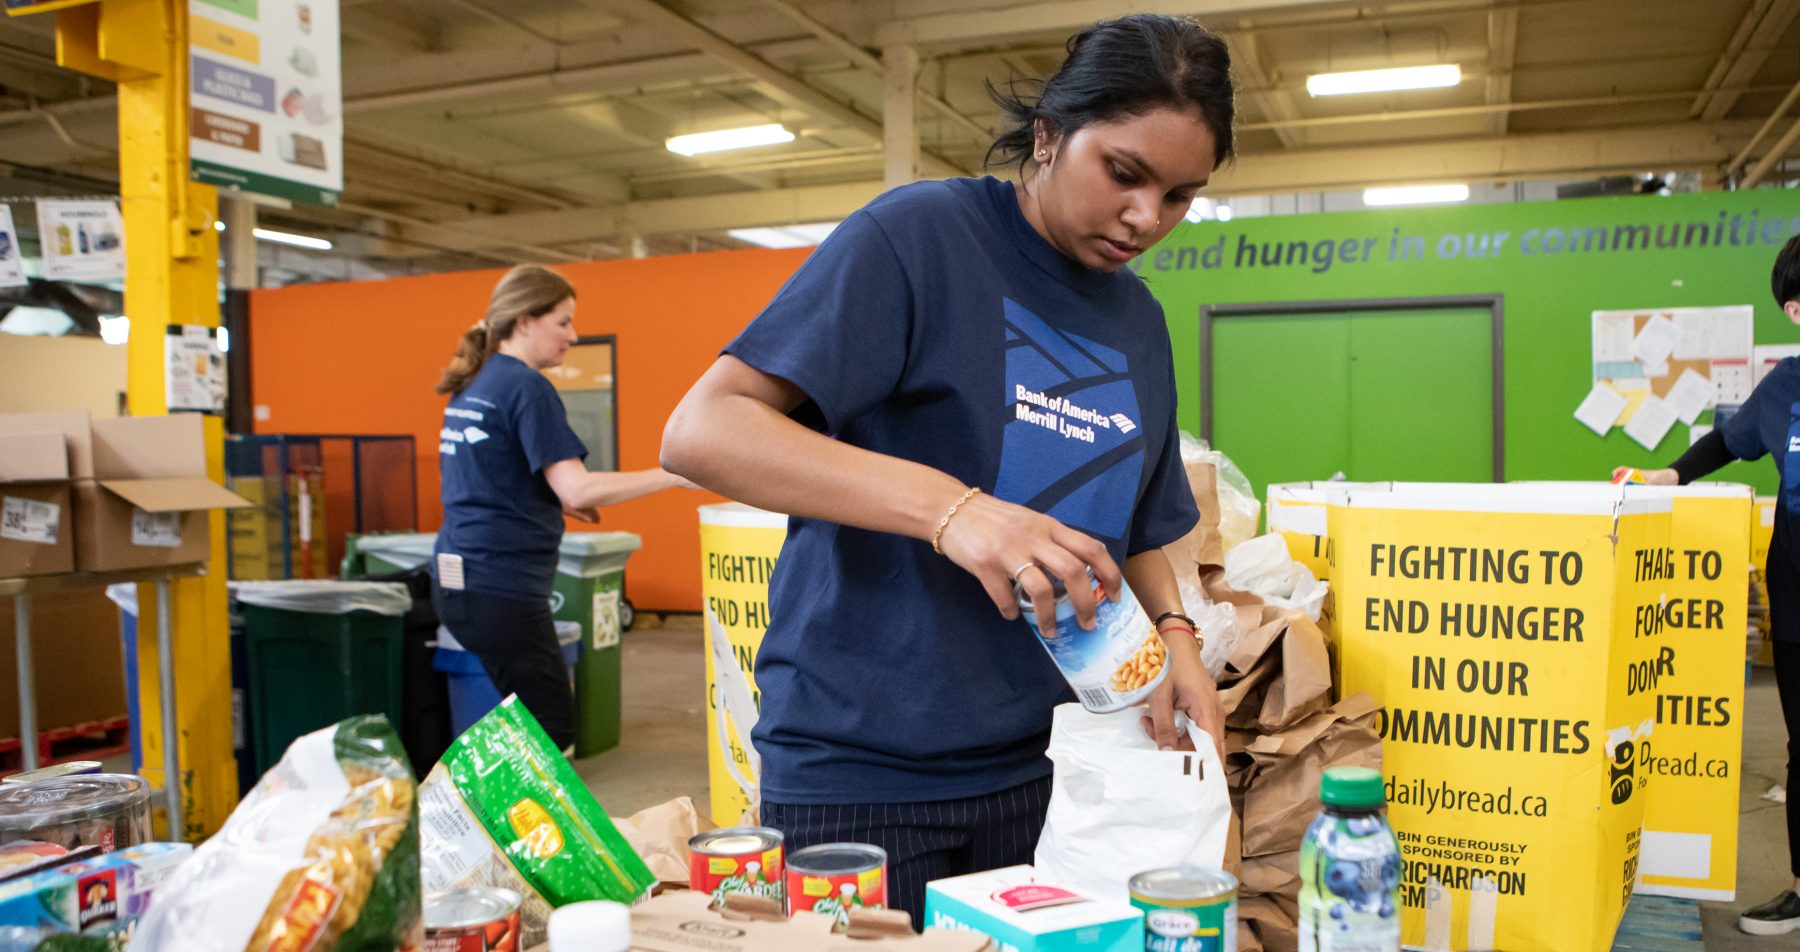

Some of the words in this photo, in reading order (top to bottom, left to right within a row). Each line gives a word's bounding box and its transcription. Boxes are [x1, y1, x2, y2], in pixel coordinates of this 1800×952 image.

[1154, 235, 1226, 272] end
[1234, 233, 1378, 274] hunger
[1387, 226, 1425, 261] in
[1437, 230, 1510, 260] our
[1016, 384, 1048, 409] Bank
[1048, 397, 1062, 413] of
[1061, 399, 1110, 429] America
[1016, 403, 1057, 431] Merrill
[1060, 417, 1095, 443] Lynch
[709, 552, 777, 584] FIGHTIN
[1370, 544, 1529, 584] FIGHTING
[1540, 550, 1583, 586] TO
[1635, 547, 1669, 582] THA
[1684, 550, 1722, 581] TO
[1366, 598, 1429, 634] END
[1440, 602, 1585, 642] HUNGER
[1664, 598, 1724, 630] GER
[1411, 655, 1446, 691] IN
[1457, 659, 1529, 696] OUR
[1628, 659, 1659, 696] DON
[1656, 695, 1731, 727] ITIES
[1374, 708, 1590, 755] OMMUNITIES
[1649, 752, 1728, 778] read.ca
[1384, 776, 1547, 817] dailybread.ca
[1397, 831, 1421, 843] BIN
[1426, 835, 1527, 854] GENEROUSLY
[1403, 845, 1494, 864] SPONSORED
[1500, 856, 1520, 866] BY
